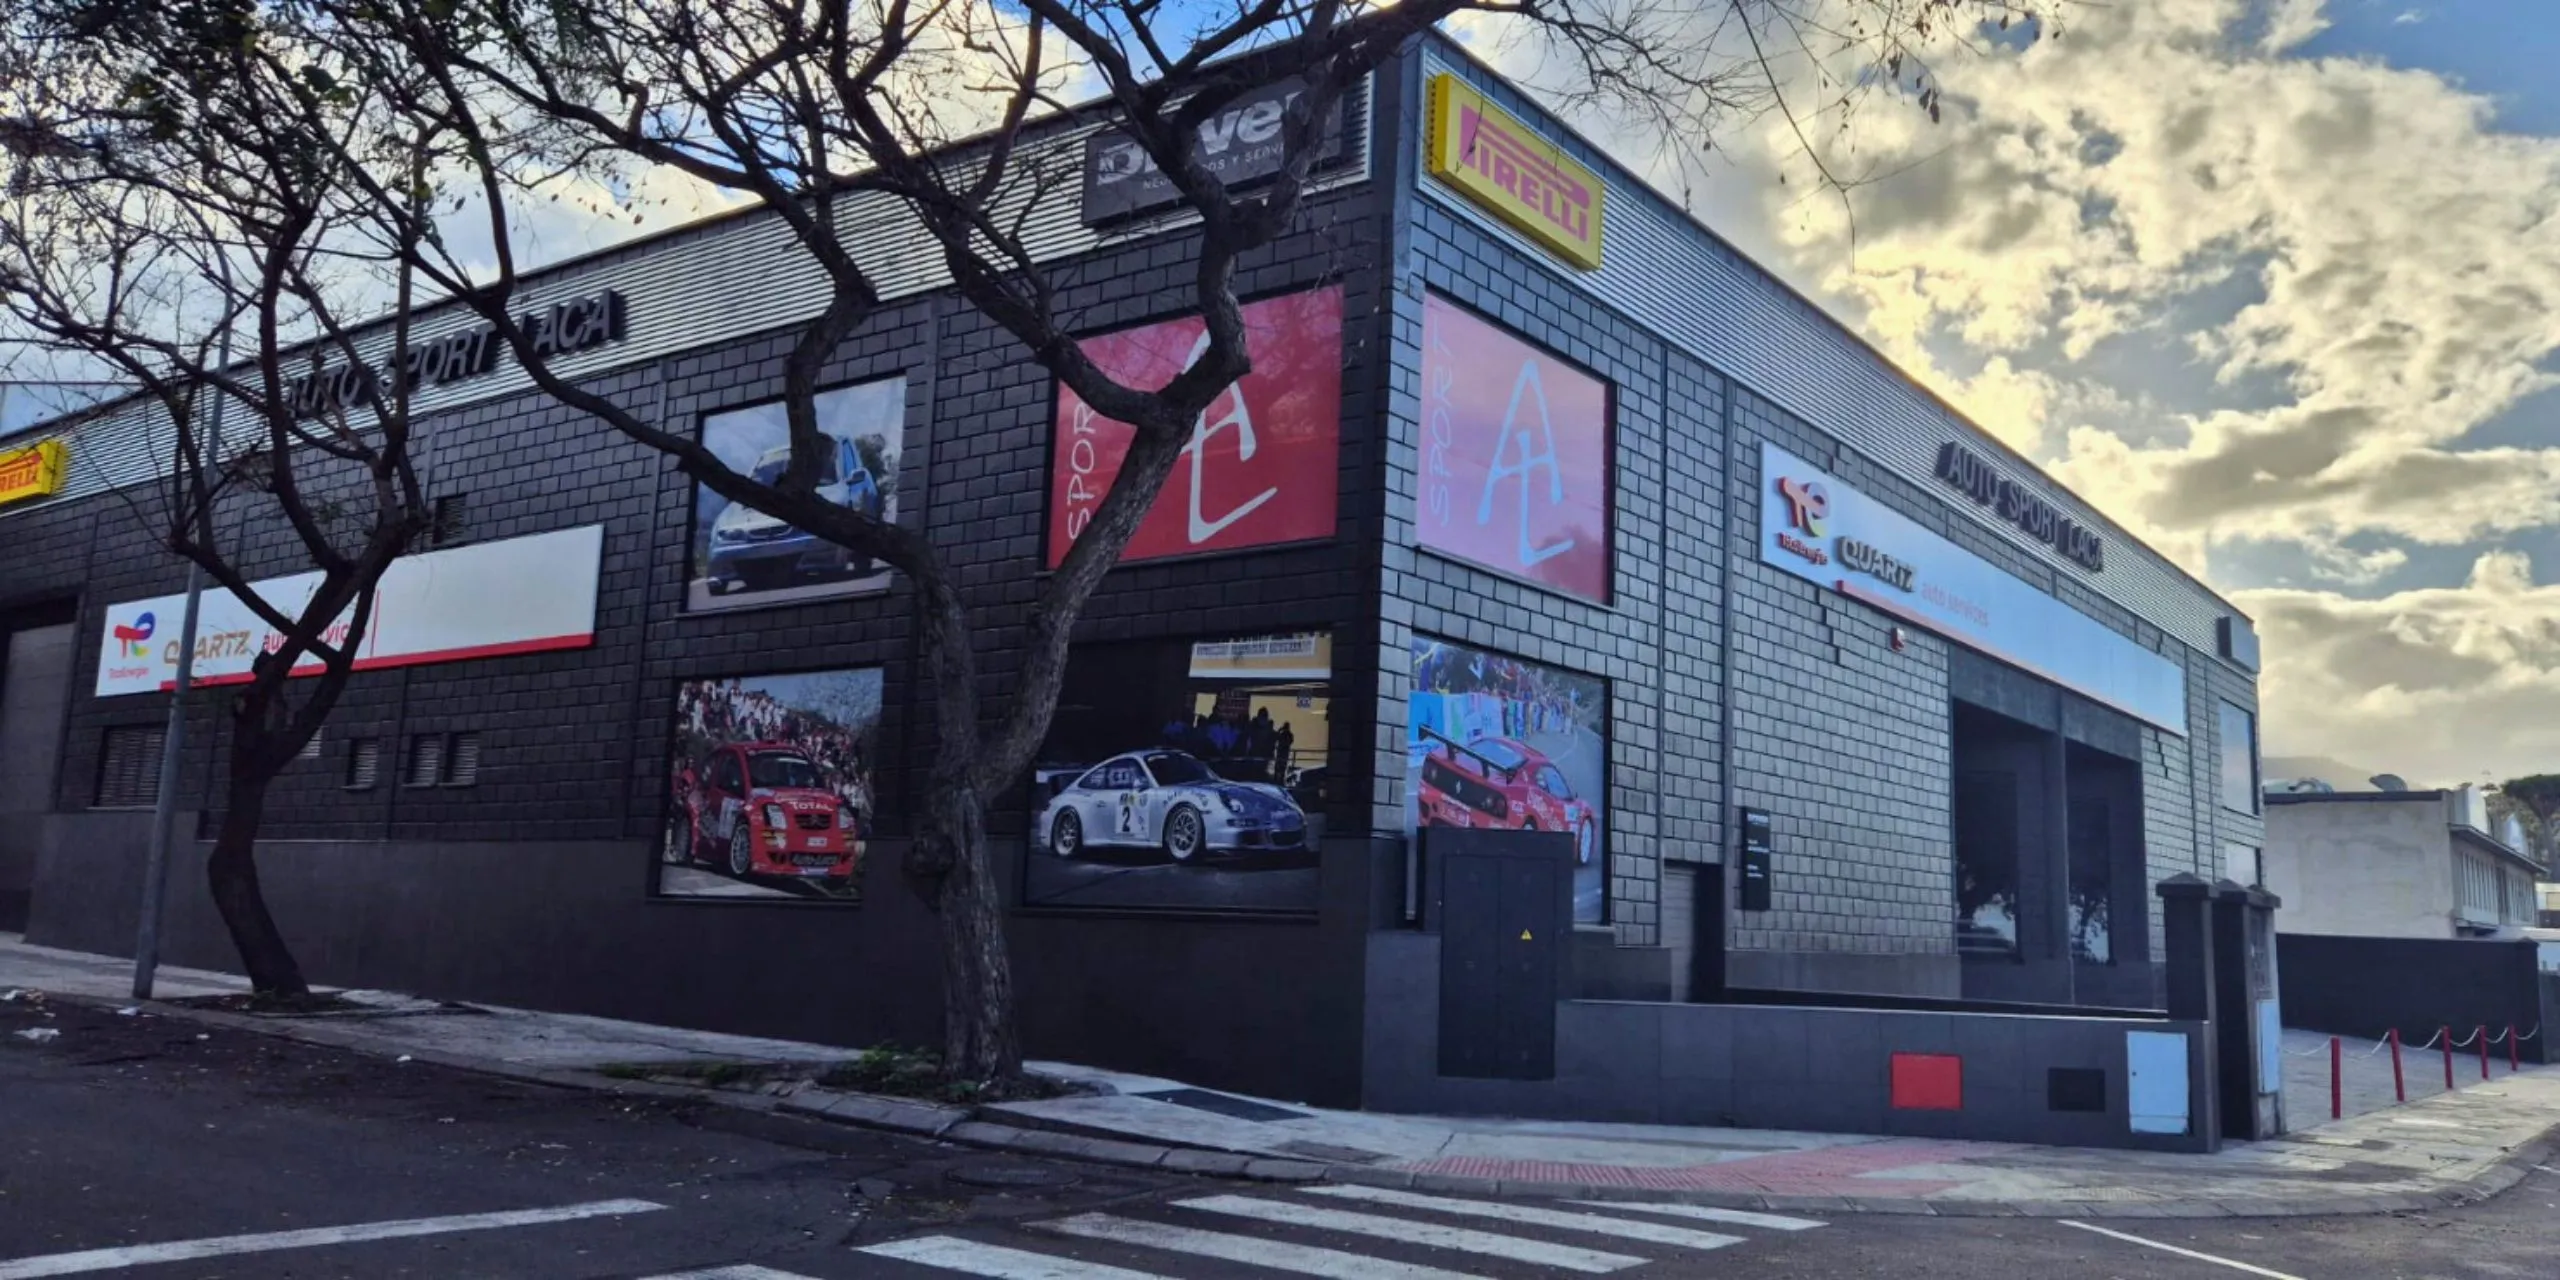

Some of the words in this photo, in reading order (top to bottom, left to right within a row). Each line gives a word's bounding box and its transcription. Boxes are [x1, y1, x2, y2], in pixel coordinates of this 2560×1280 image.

[1459, 103, 1591, 243] PIRELLI
[1429, 312, 1454, 528] SPORT
[1066, 401, 1098, 541] SPOR
[1940, 441, 2000, 502] AUTO
[2004, 481, 2062, 547] SPORT
[2065, 518, 2104, 574] LACA
[1838, 536, 1917, 593] QUARTZ
[164, 630, 251, 666] QARTZ
[789, 801, 834, 812] TOTAL
[1121, 806, 1131, 833] 2
